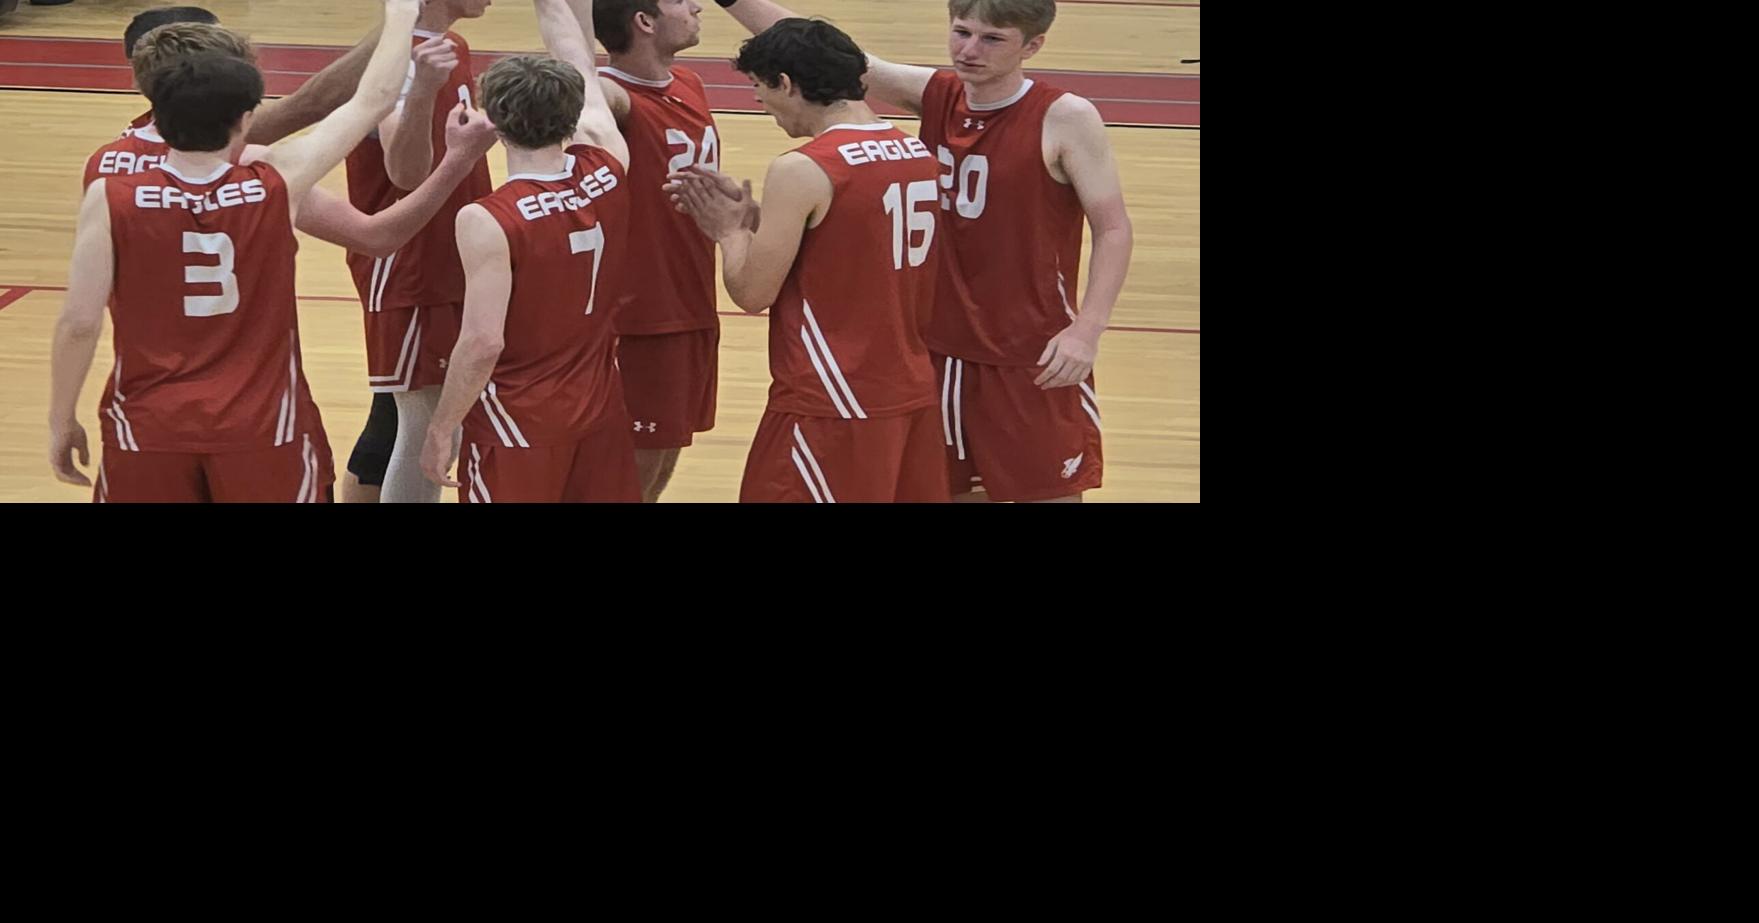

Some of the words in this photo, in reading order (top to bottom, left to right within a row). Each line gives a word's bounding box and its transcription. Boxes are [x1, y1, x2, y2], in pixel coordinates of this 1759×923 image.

[665, 125, 718, 184] 24
[837, 137, 932, 166] EAGLE
[937, 144, 989, 219] 20
[135, 179, 266, 214] EAGLES
[515, 165, 618, 221] EAGLES
[882, 179, 938, 270] 16
[182, 231, 240, 317] 3
[568, 220, 605, 316] 7
